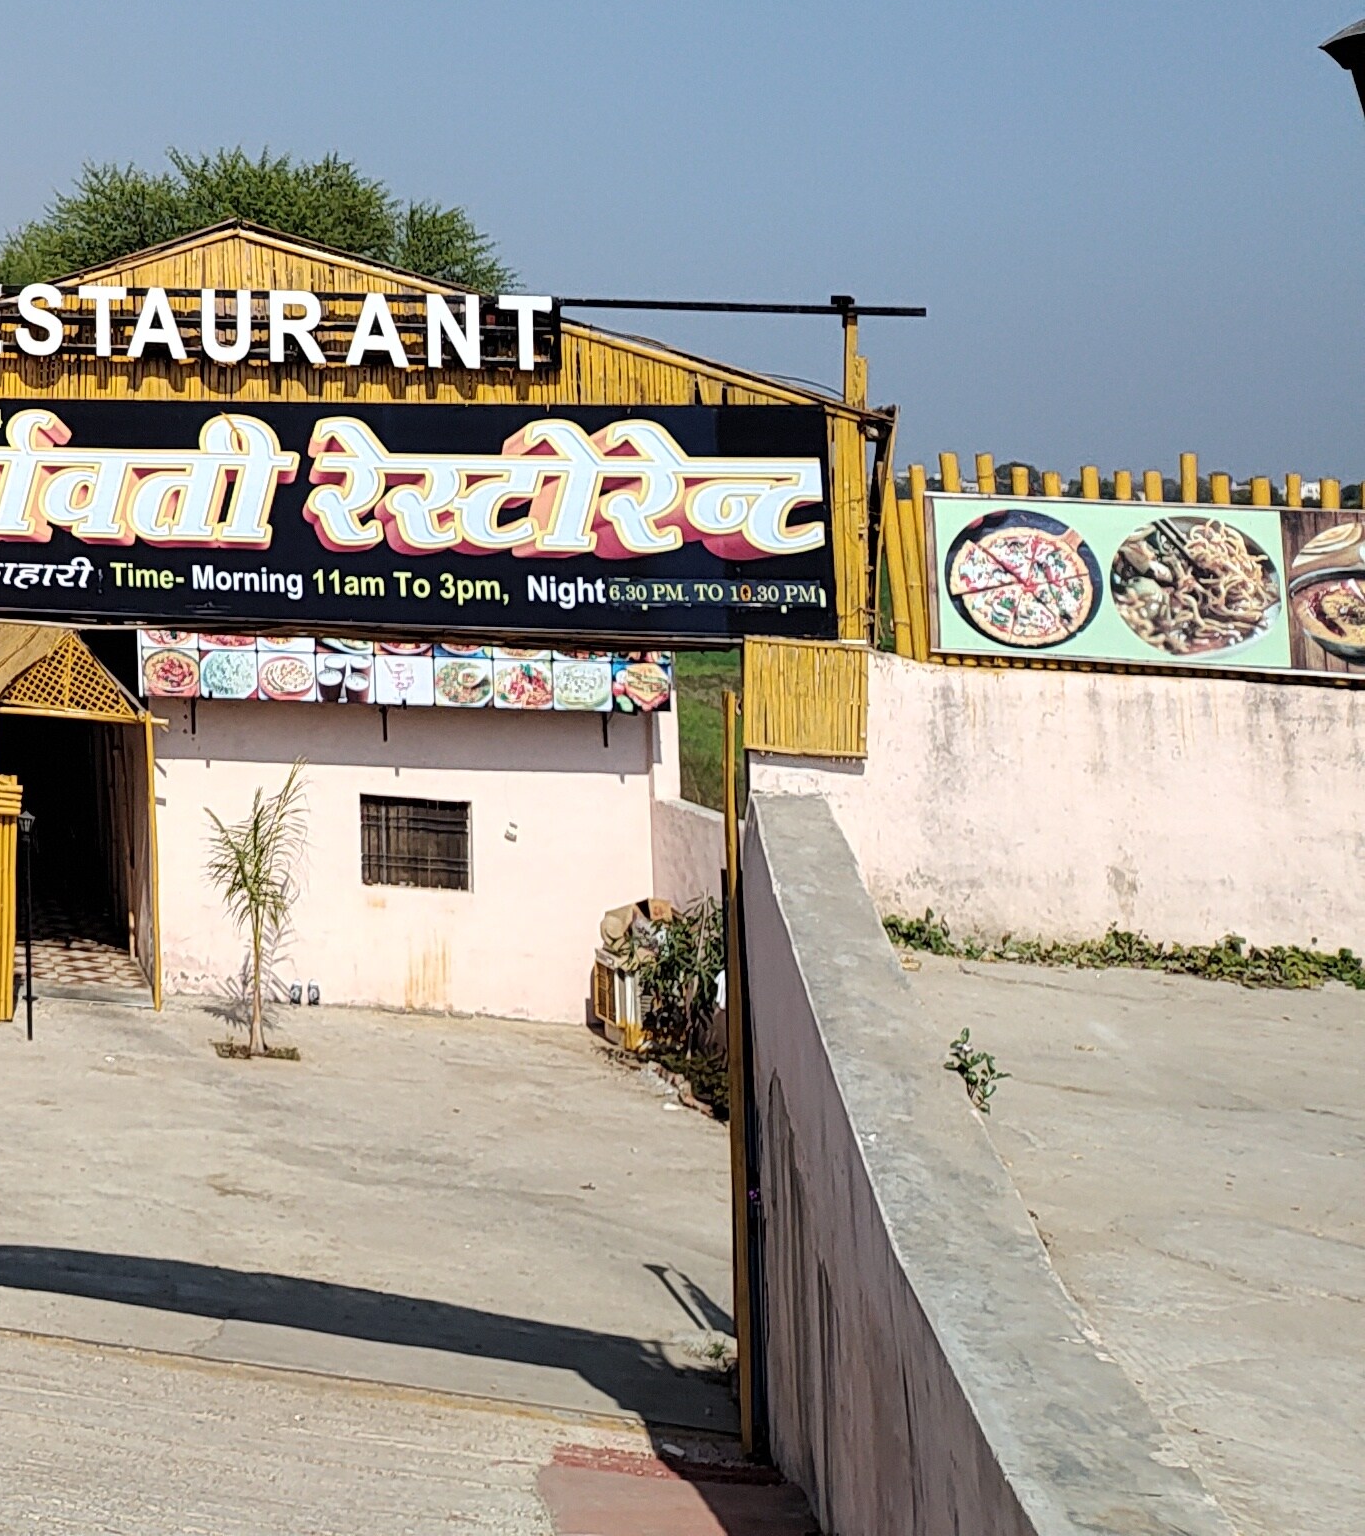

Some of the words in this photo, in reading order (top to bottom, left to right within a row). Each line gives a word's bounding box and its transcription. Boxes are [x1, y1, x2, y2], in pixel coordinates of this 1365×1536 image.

[110, 562, 185, 589] Time-
[191, 564, 303, 600] Morning
[312, 568, 385, 596] 11am
[394, 571, 431, 598] To
[439, 573, 510, 605] 3pm,
[527, 575, 606, 610] Night
[609, 584, 647, 601] 6.30
[694, 584, 724, 601] TO
[785, 585, 818, 604] PM
